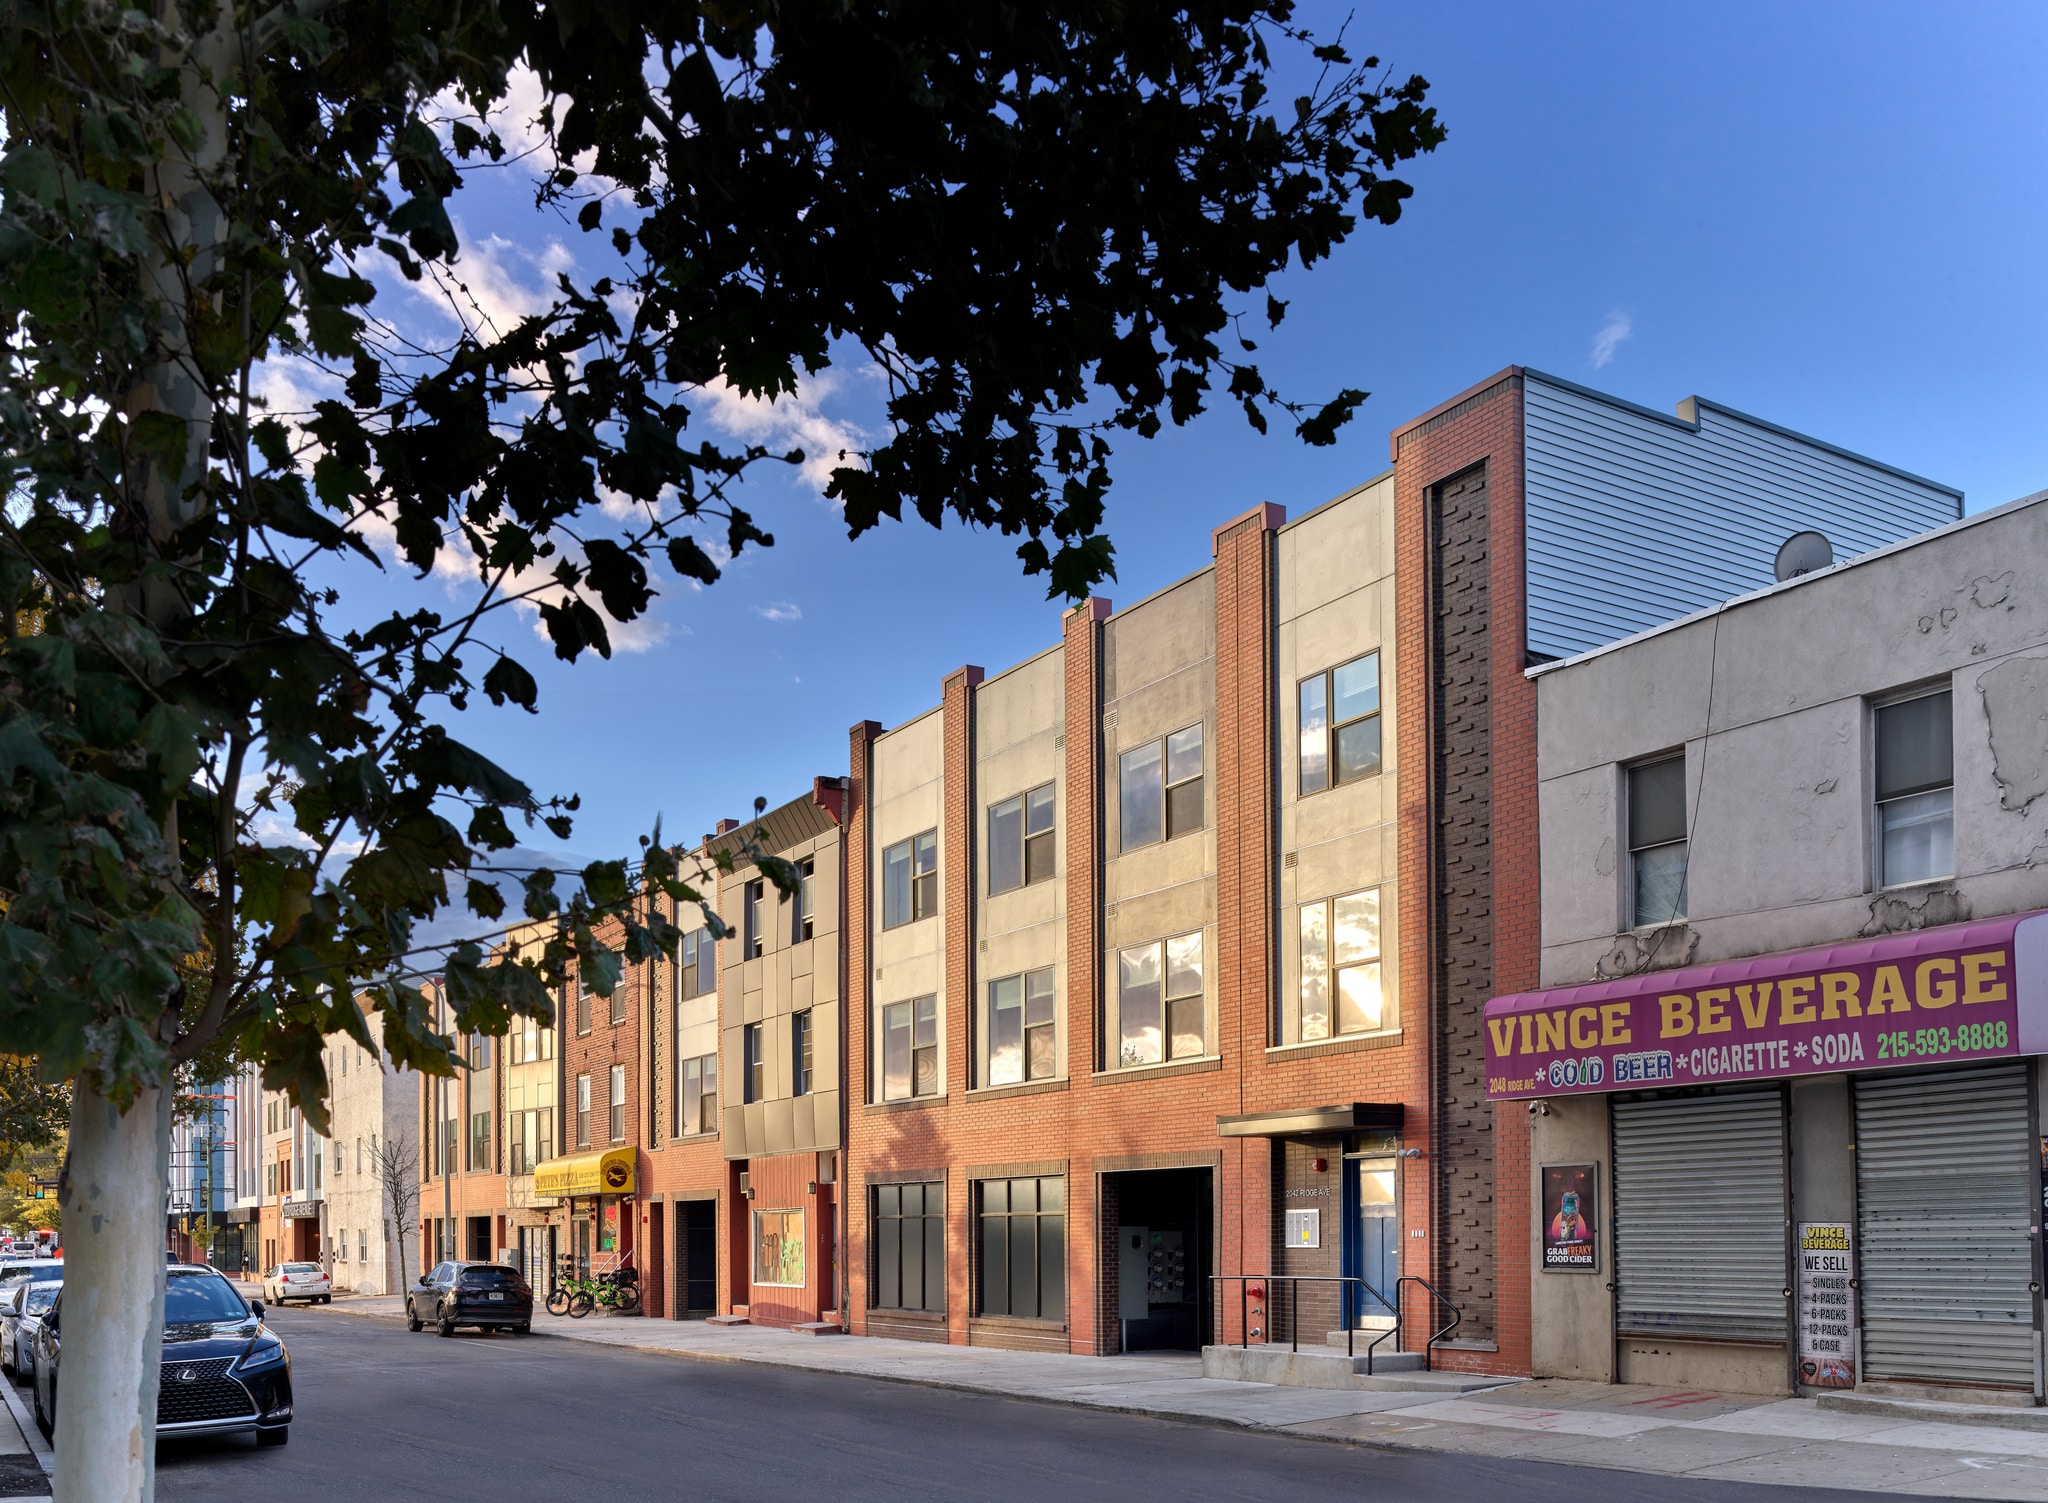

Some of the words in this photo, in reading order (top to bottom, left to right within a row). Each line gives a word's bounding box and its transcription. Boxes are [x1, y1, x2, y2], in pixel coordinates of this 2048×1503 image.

[1488, 1002, 1632, 1057] VINCE
[1658, 950, 2008, 1039] BEVERAGE
[1613, 1050, 1674, 1083] BEER
[1690, 1039, 1790, 1077] CIGARETTE
[1811, 1031, 1864, 1066] SODA
[1877, 1020, 2009, 1060] 215-593-8888
[1489, 1076, 1506, 1093] 2048
[1507, 1080, 1523, 1092] RIDGE
[1524, 1078, 1536, 1090] AVE.
[560, 1171, 579, 1187] PIZZA
[1319, 1188, 1330, 1196] AVE
[1806, 1227, 1845, 1238] VINCE
[1802, 1238, 1850, 1250] BEVERAGE
[1547, 1247, 1567, 1255] GRAB
[1567, 1245, 1592, 1256] FREAKY
[1547, 1255, 1569, 1263] GOOD
[1569, 1255, 1592, 1263] CIDER
[1804, 1256, 1820, 1270] WE
[1823, 1256, 1848, 1271] SELL
[1812, 1277, 1846, 1289] SINGLES
[1811, 1293, 1847, 1305] 4-PACKS
[1811, 1308, 1847, 1320] 6-PACKS
[1809, 1323, 1848, 1336] 12-PACKS
[1819, 1340, 1841, 1351] CASE
[1822, 1367, 1847, 1377] VICTORY
